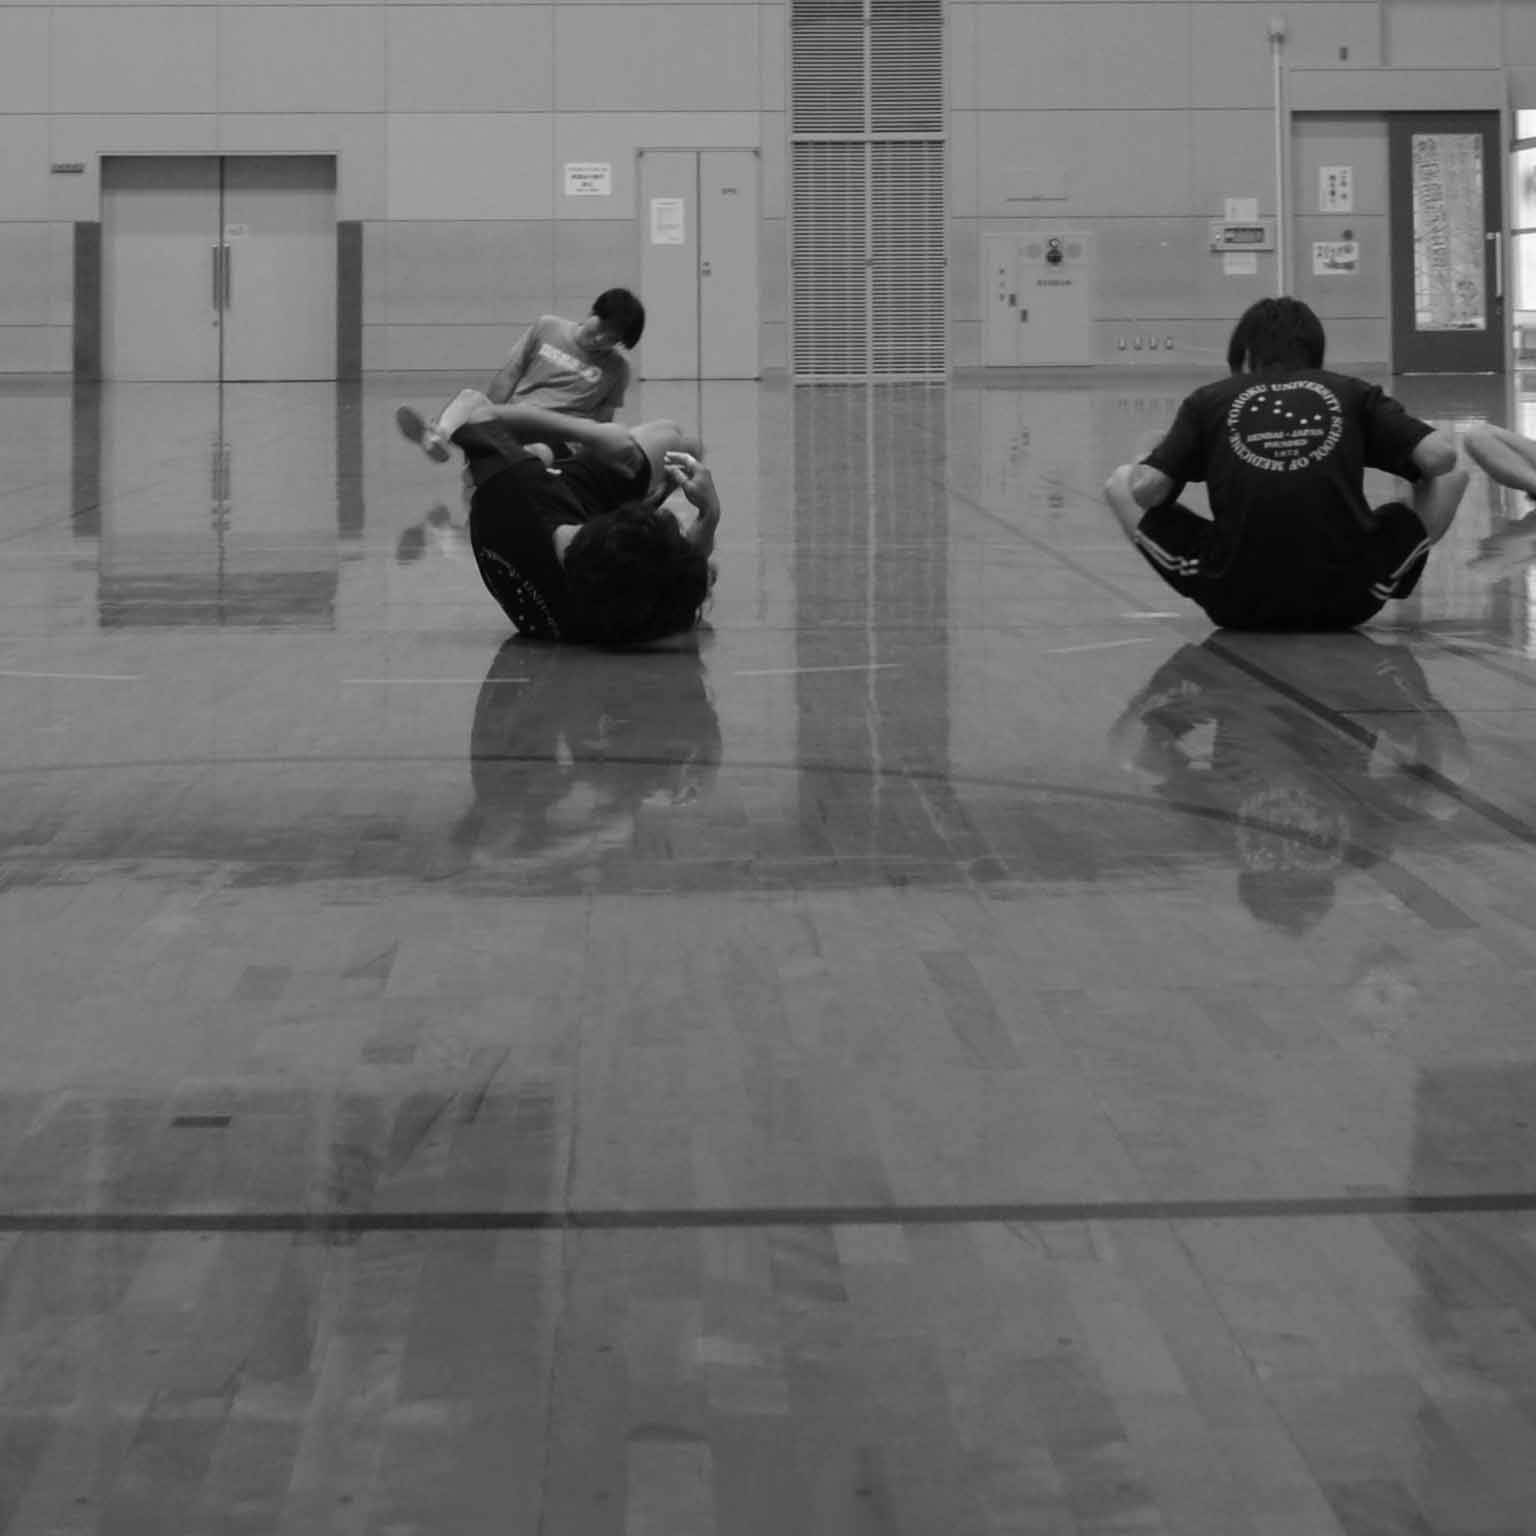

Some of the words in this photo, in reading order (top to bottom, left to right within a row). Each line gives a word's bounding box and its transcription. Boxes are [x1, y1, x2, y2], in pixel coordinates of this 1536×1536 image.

[1227, 384, 1267, 426] TOHOKU
[1270, 380, 1342, 413] UNIVERSITY
[1228, 433, 1284, 471] MEDICINE
[1309, 416, 1343, 461] SCHOOL
[1288, 456, 1310, 471] OF
